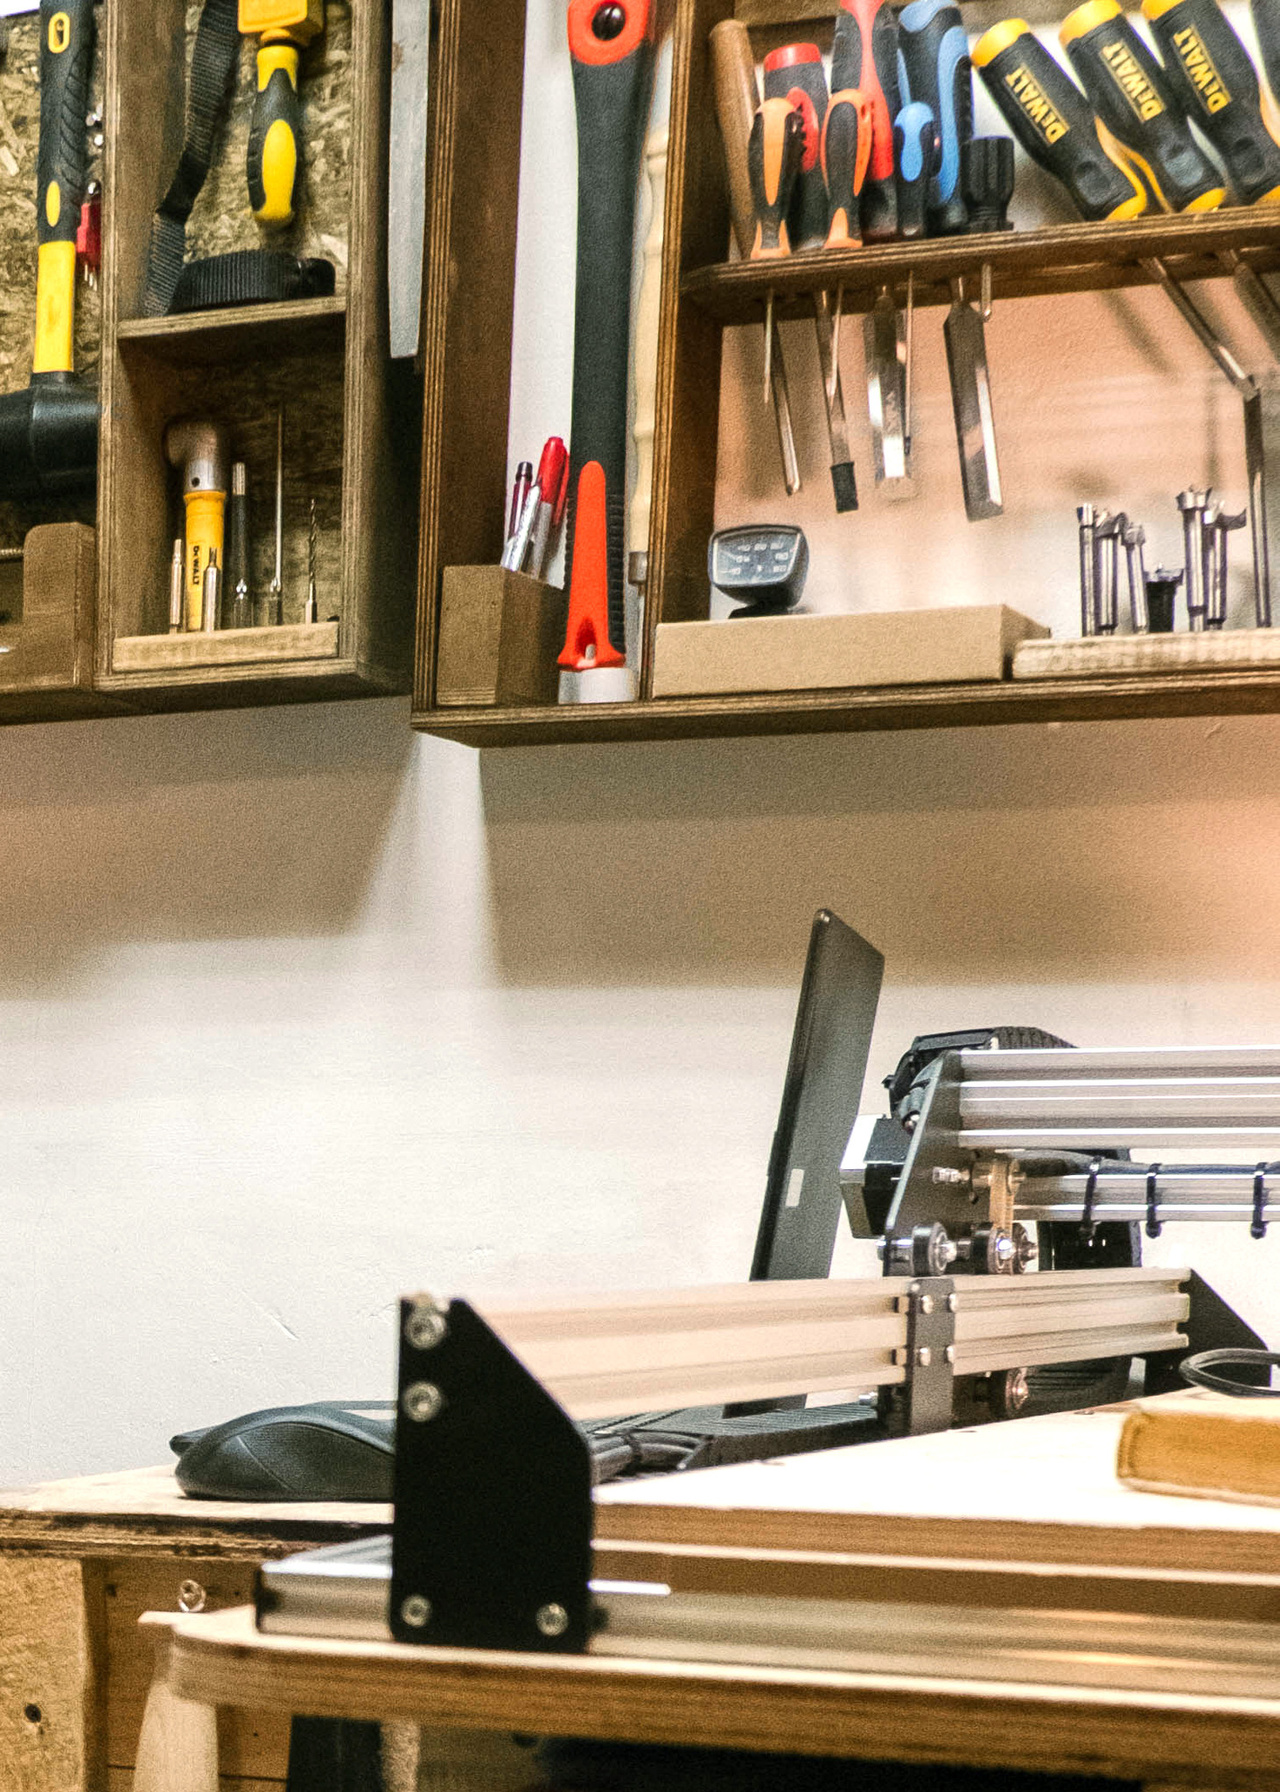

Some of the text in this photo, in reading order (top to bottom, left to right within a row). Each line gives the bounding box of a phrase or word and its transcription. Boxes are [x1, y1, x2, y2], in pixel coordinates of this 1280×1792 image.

[1004, 66, 1067, 144] DEWALT
[1102, 41, 1163, 121] DEWALT
[1173, 27, 1228, 114] DEWALT
